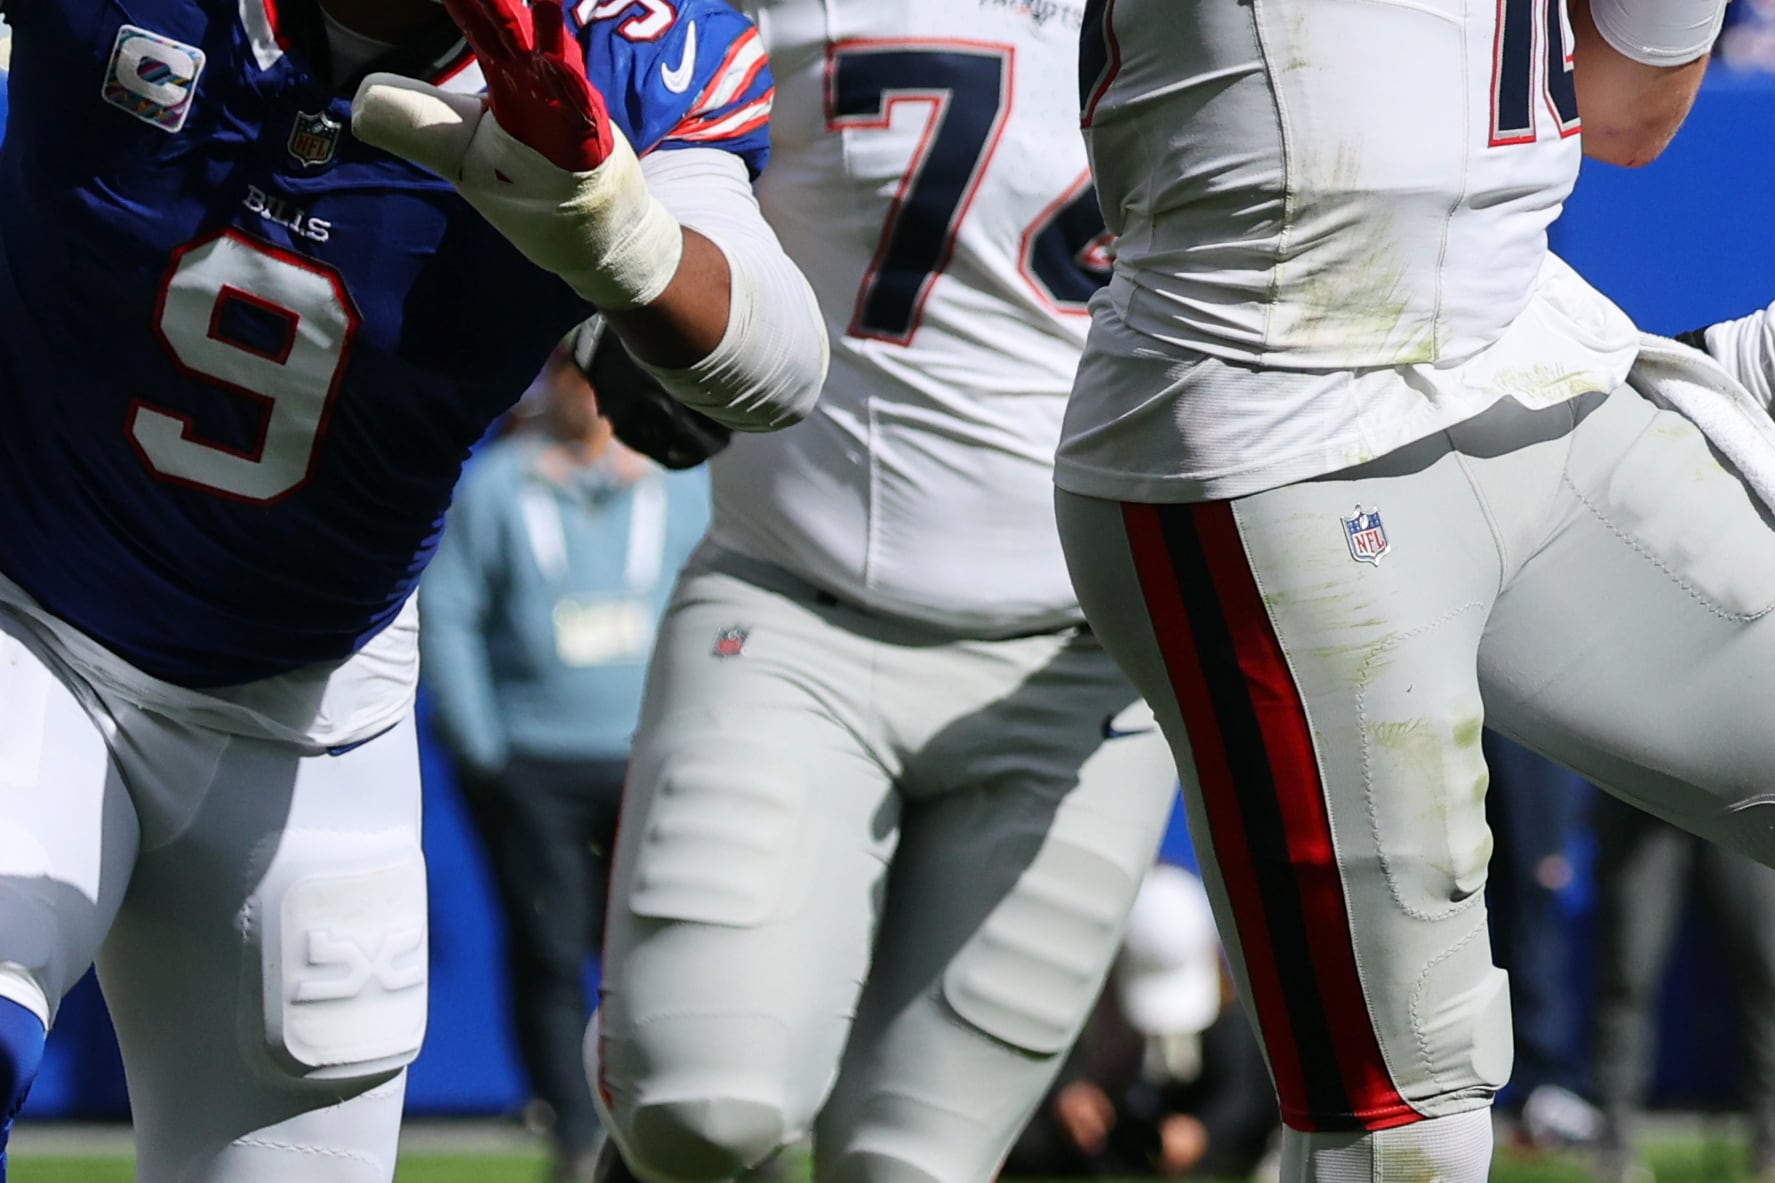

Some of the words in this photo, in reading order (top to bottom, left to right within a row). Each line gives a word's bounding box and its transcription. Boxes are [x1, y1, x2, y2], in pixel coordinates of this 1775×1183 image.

[116, 36, 195, 107] C
[294, 132, 329, 159] NFL
[242, 184, 333, 243] BILLS
[123, 225, 365, 507] 9
[1353, 529, 1385, 555] NFL
